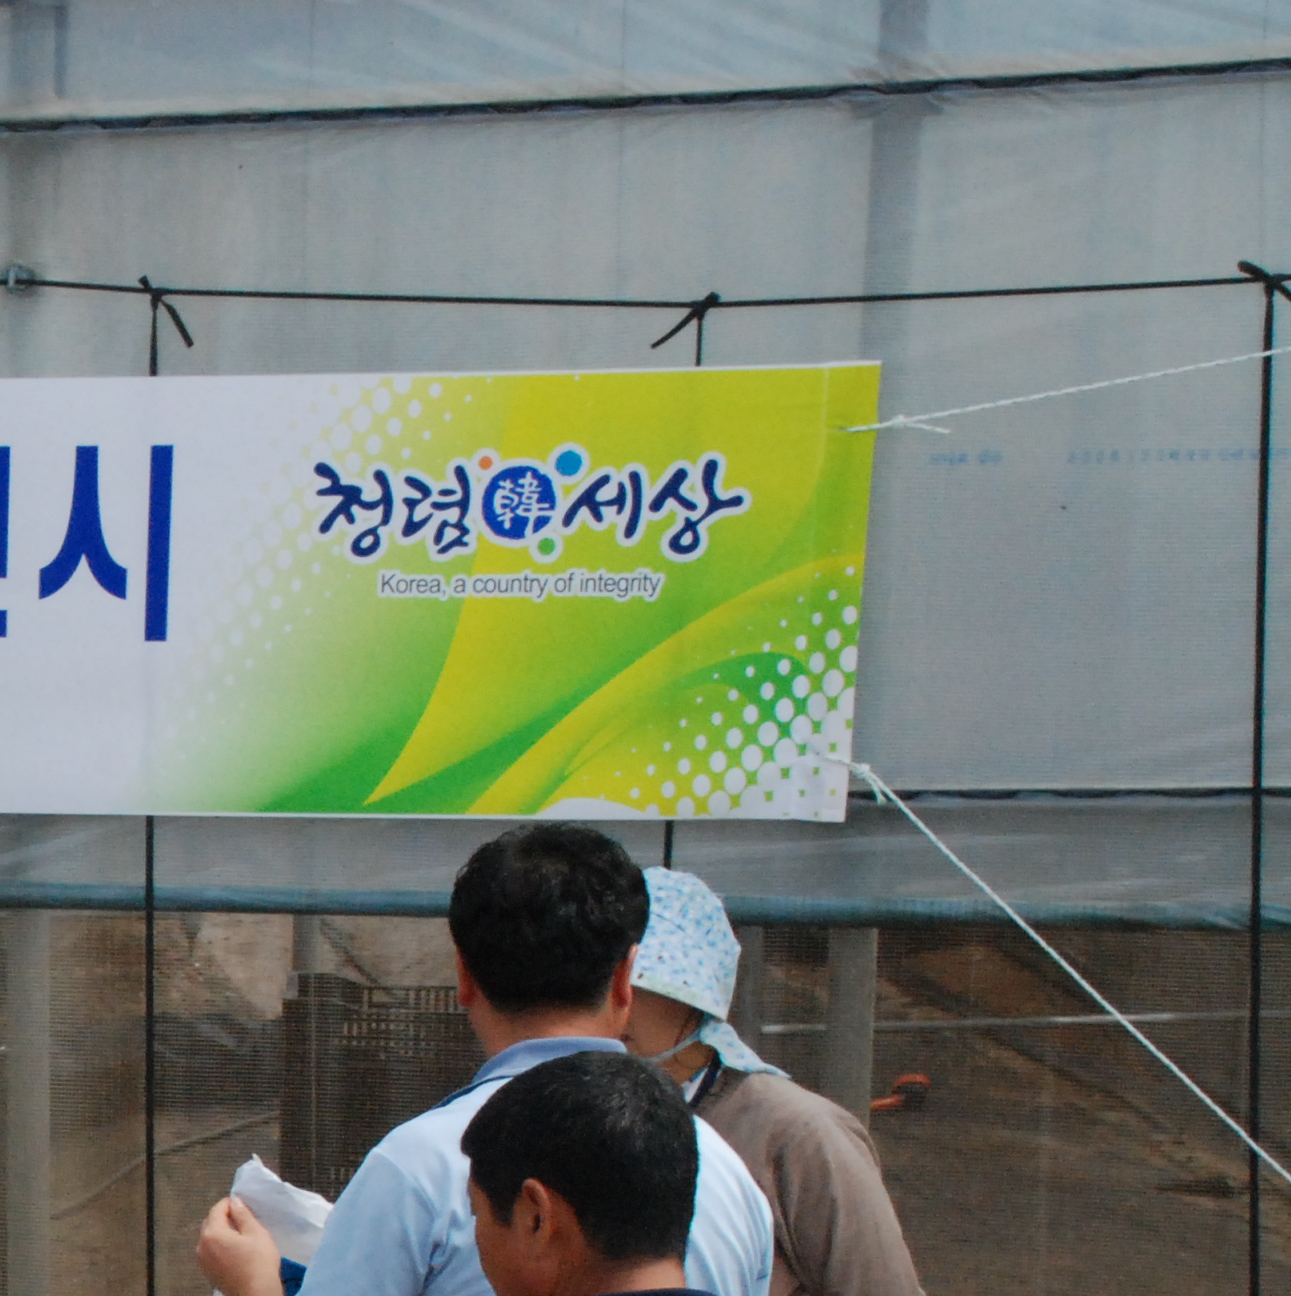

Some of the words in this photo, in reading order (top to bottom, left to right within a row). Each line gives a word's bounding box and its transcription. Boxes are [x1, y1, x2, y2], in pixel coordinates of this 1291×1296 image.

[380, 573, 446, 597] Korea,
[453, 579, 467, 594] a
[472, 574, 549, 598] country
[554, 573, 576, 593] of
[580, 573, 662, 598] integrity
